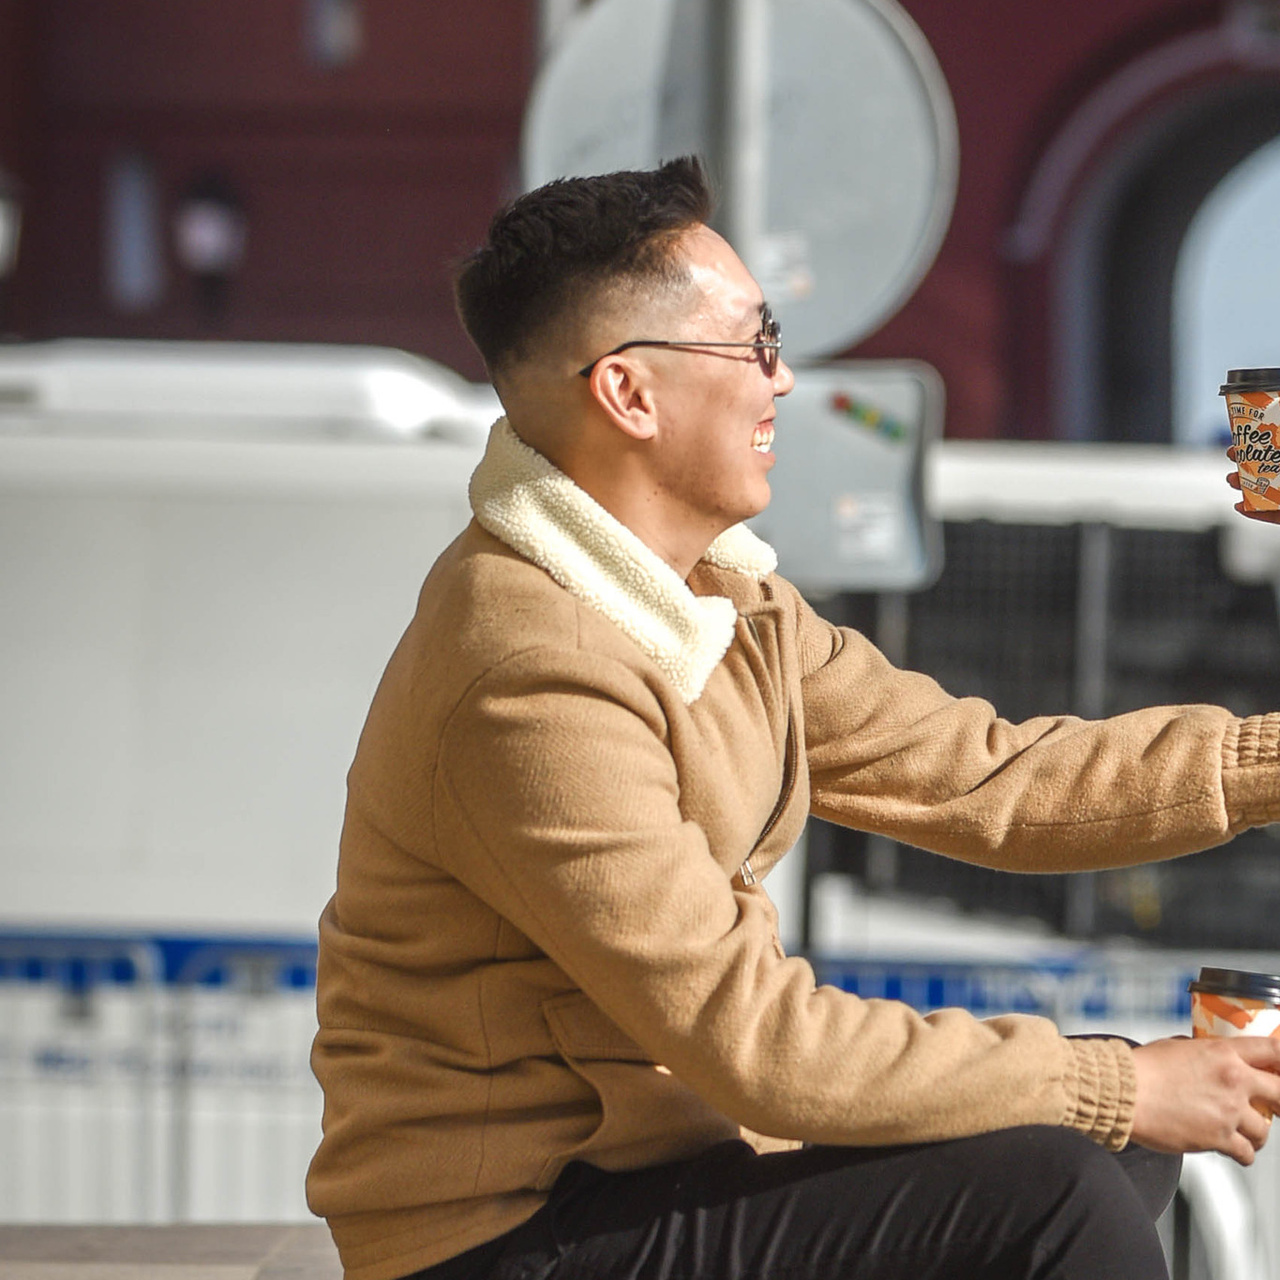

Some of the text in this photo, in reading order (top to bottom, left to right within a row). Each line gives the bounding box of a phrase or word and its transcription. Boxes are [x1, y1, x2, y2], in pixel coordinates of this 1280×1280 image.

[1231, 406, 1265, 420] TIME FOR
[1232, 424, 1271, 446] offee
[1258, 462, 1280, 473] tea
